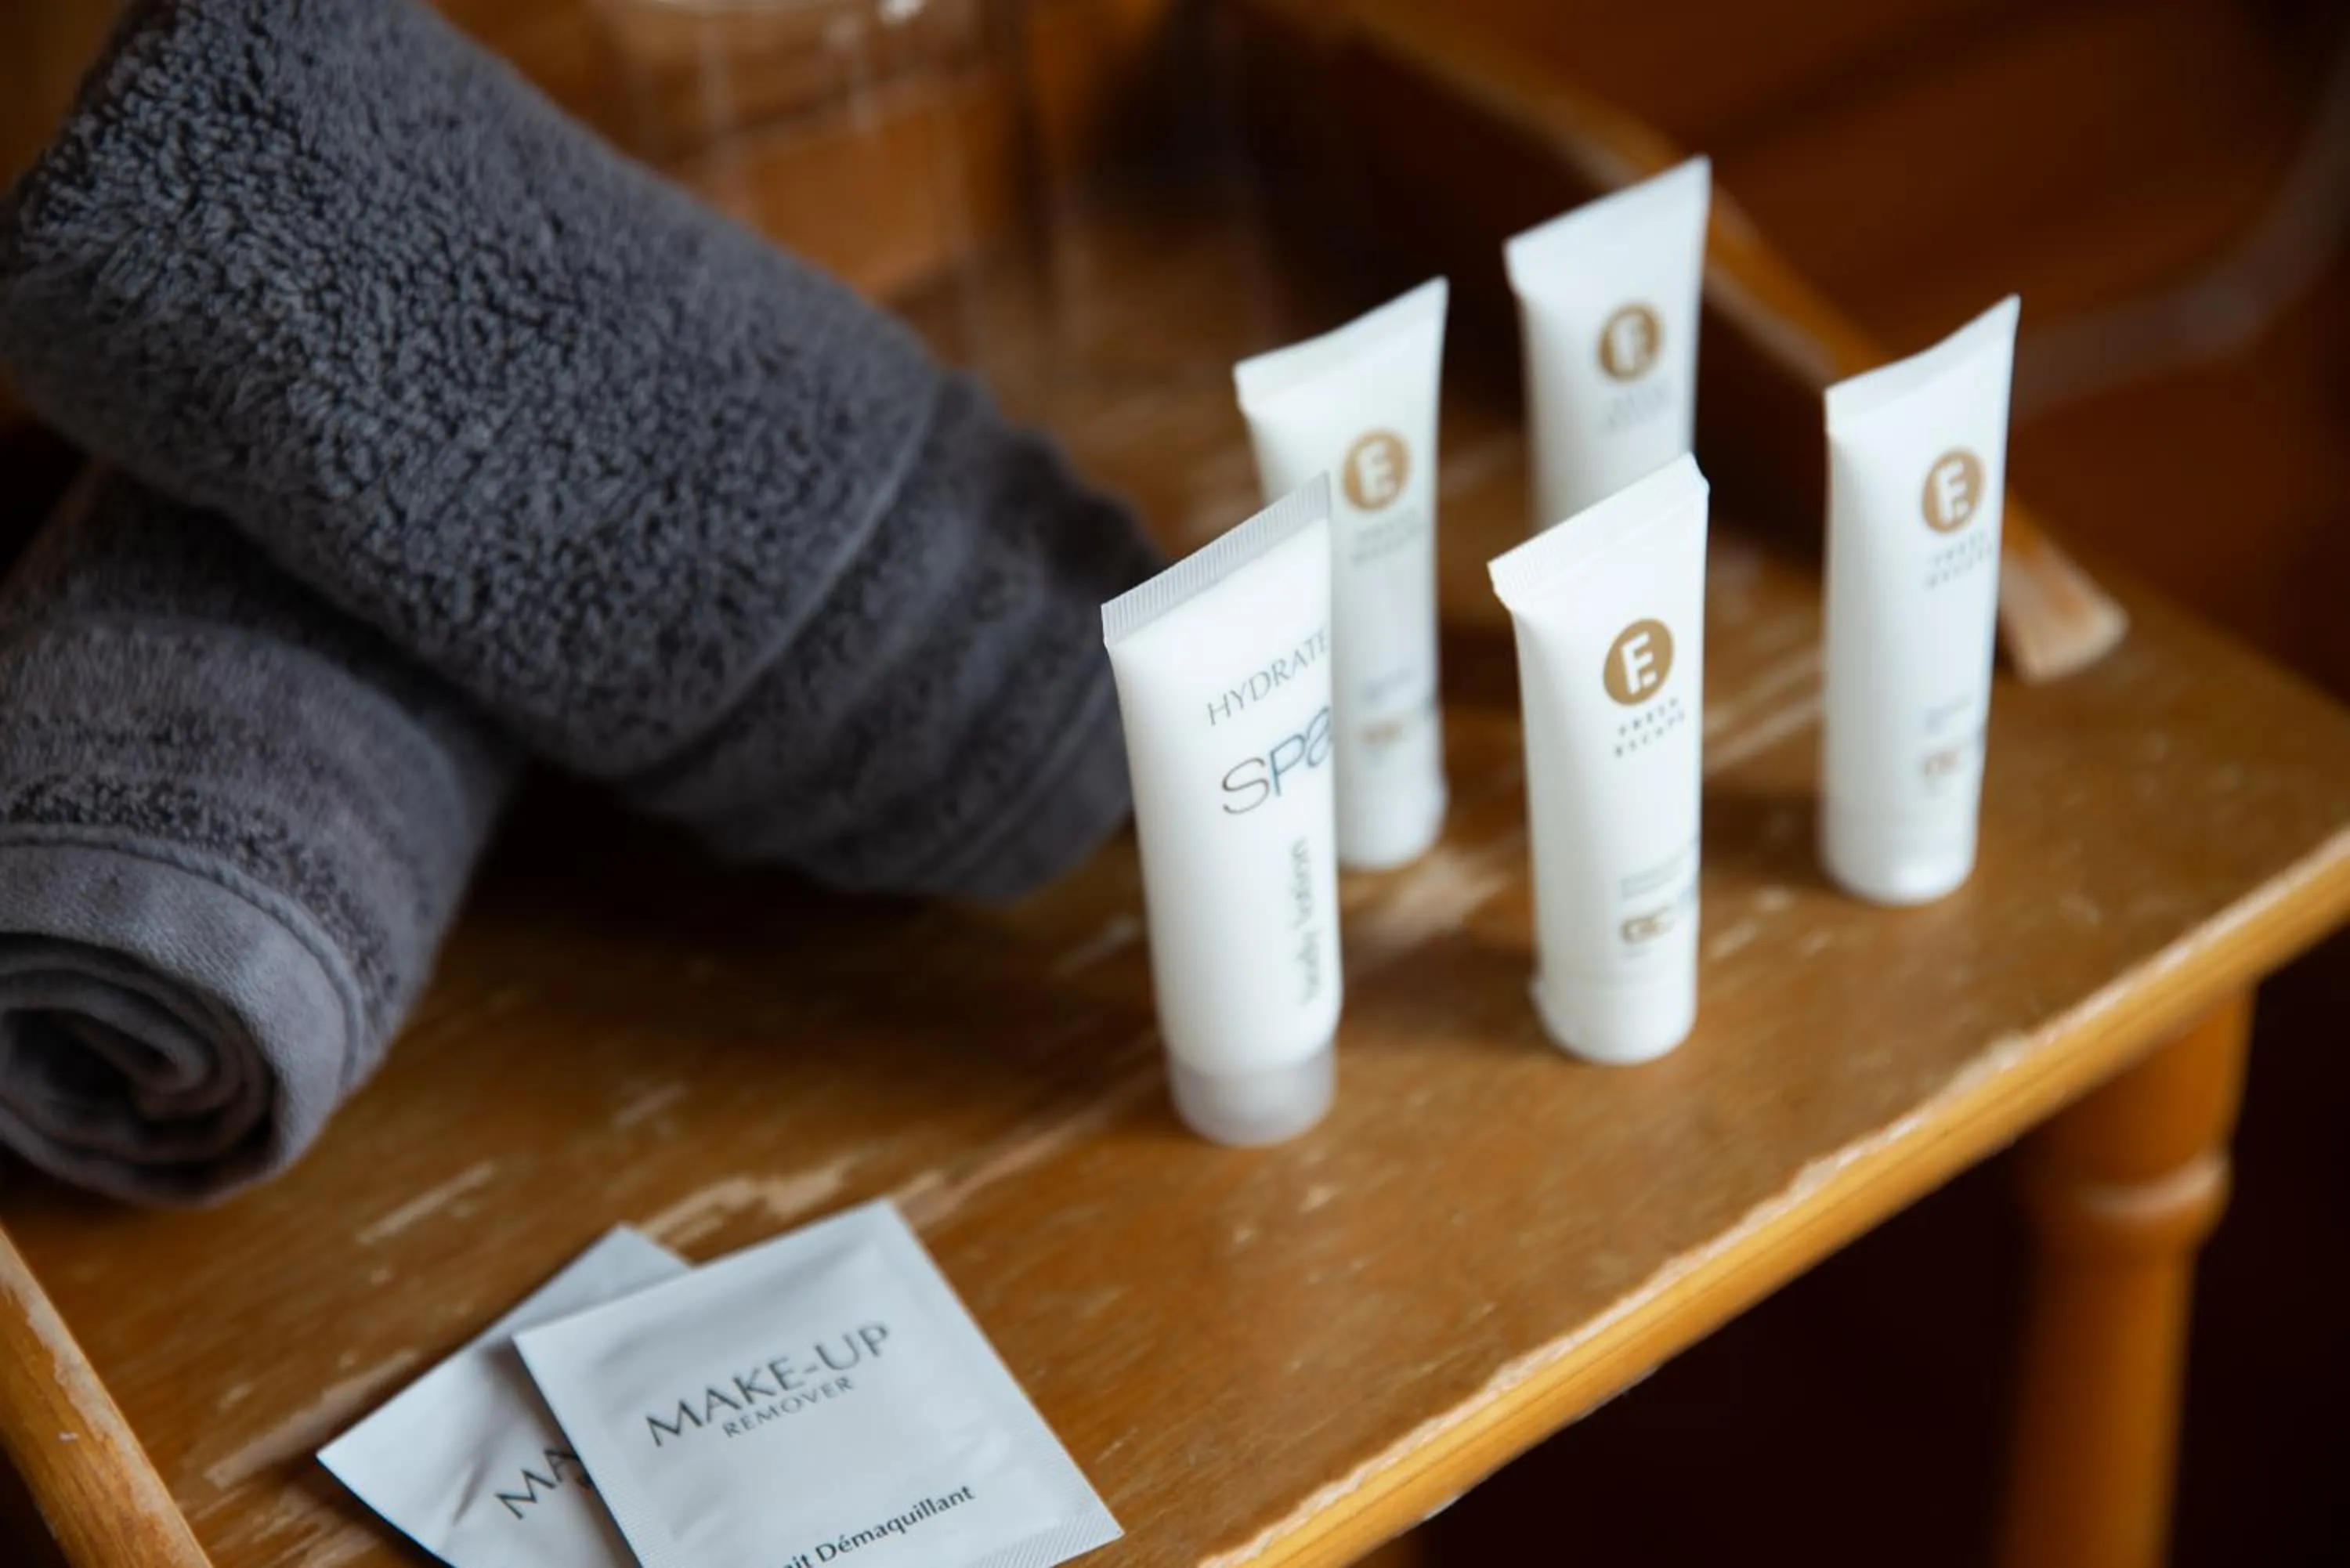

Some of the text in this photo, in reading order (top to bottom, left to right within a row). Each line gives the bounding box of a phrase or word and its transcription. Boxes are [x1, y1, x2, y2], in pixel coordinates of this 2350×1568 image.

[645, 1322, 890, 1447] MAKE-UP
[721, 1376, 854, 1438] REMOVER
[815, 1486, 975, 1562] Démaquillant
